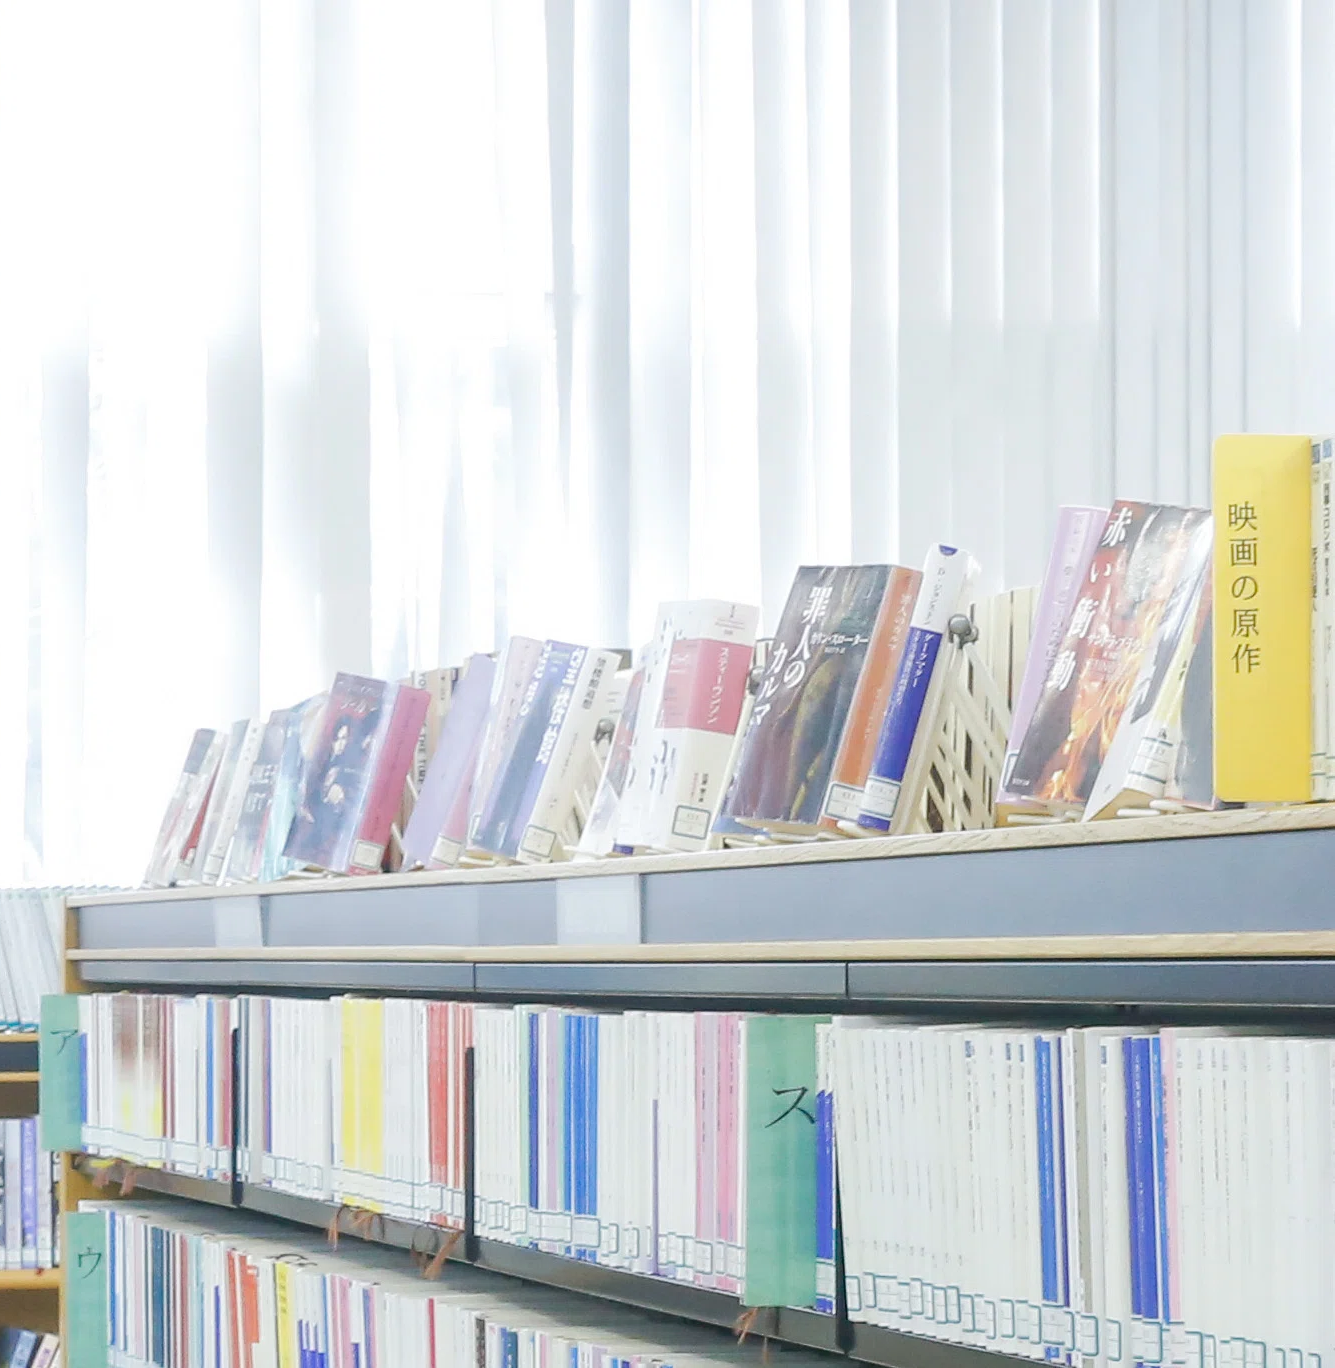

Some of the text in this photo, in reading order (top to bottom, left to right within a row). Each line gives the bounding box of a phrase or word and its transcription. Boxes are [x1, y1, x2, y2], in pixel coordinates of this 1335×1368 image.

[1048, 506, 1134, 692] 赤い衝動
[1228, 501, 1261, 674] 映画の原作
[783, 586, 833, 689] 罪人の
[749, 642, 789, 727] カルマ
[49, 1028, 79, 1055] ア
[764, 1086, 817, 1129] ス
[77, 1246, 103, 1279] ウ
